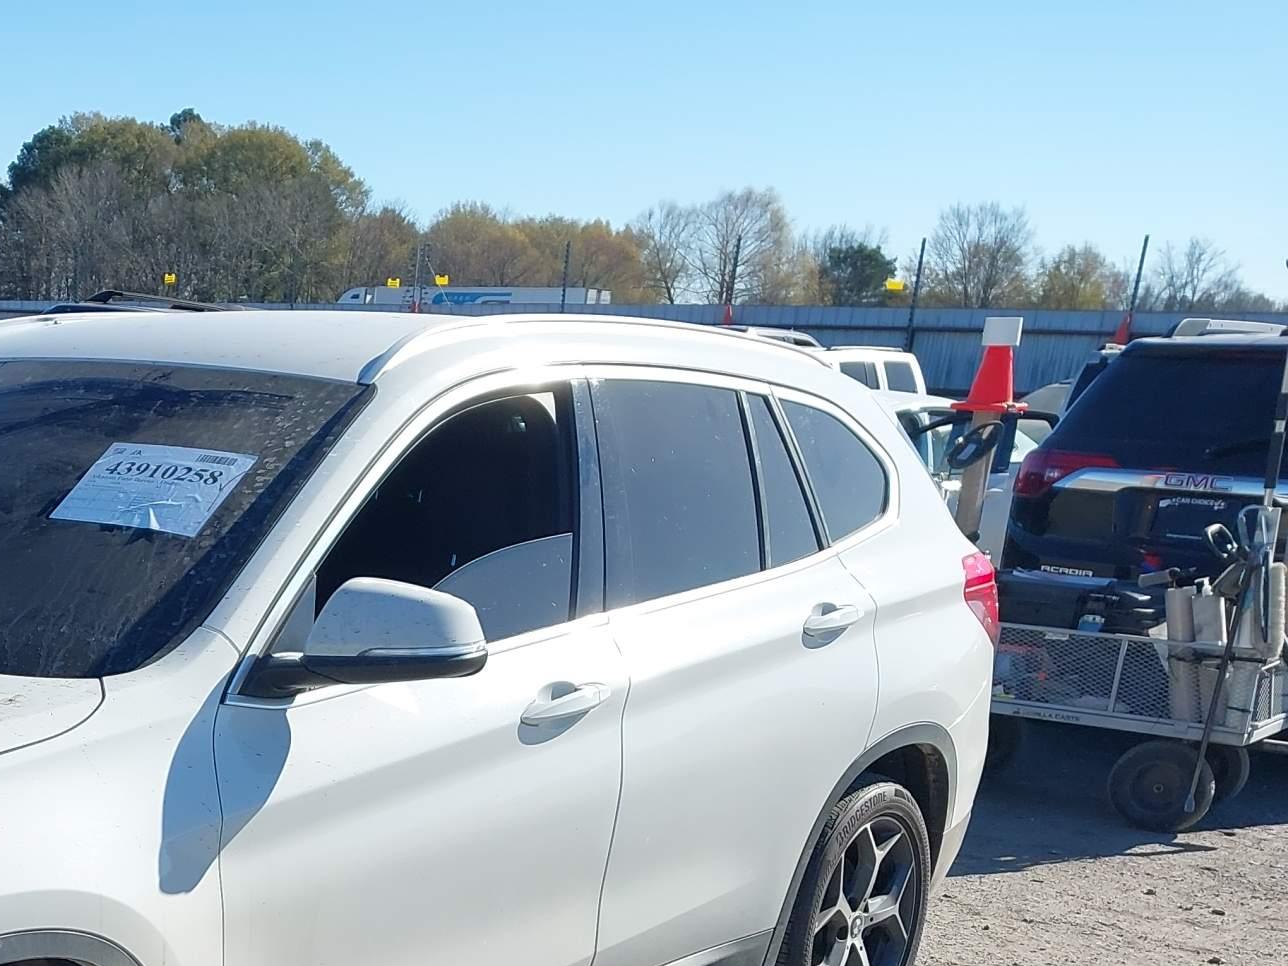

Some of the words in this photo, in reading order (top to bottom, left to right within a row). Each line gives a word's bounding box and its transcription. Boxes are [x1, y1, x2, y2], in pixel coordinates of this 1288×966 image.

[105, 460, 224, 486] 43910258
[1164, 473, 1233, 491] GMC
[1041, 565, 1093, 577] ACADIA
[836, 791, 887, 848] BRIDGESTONE
